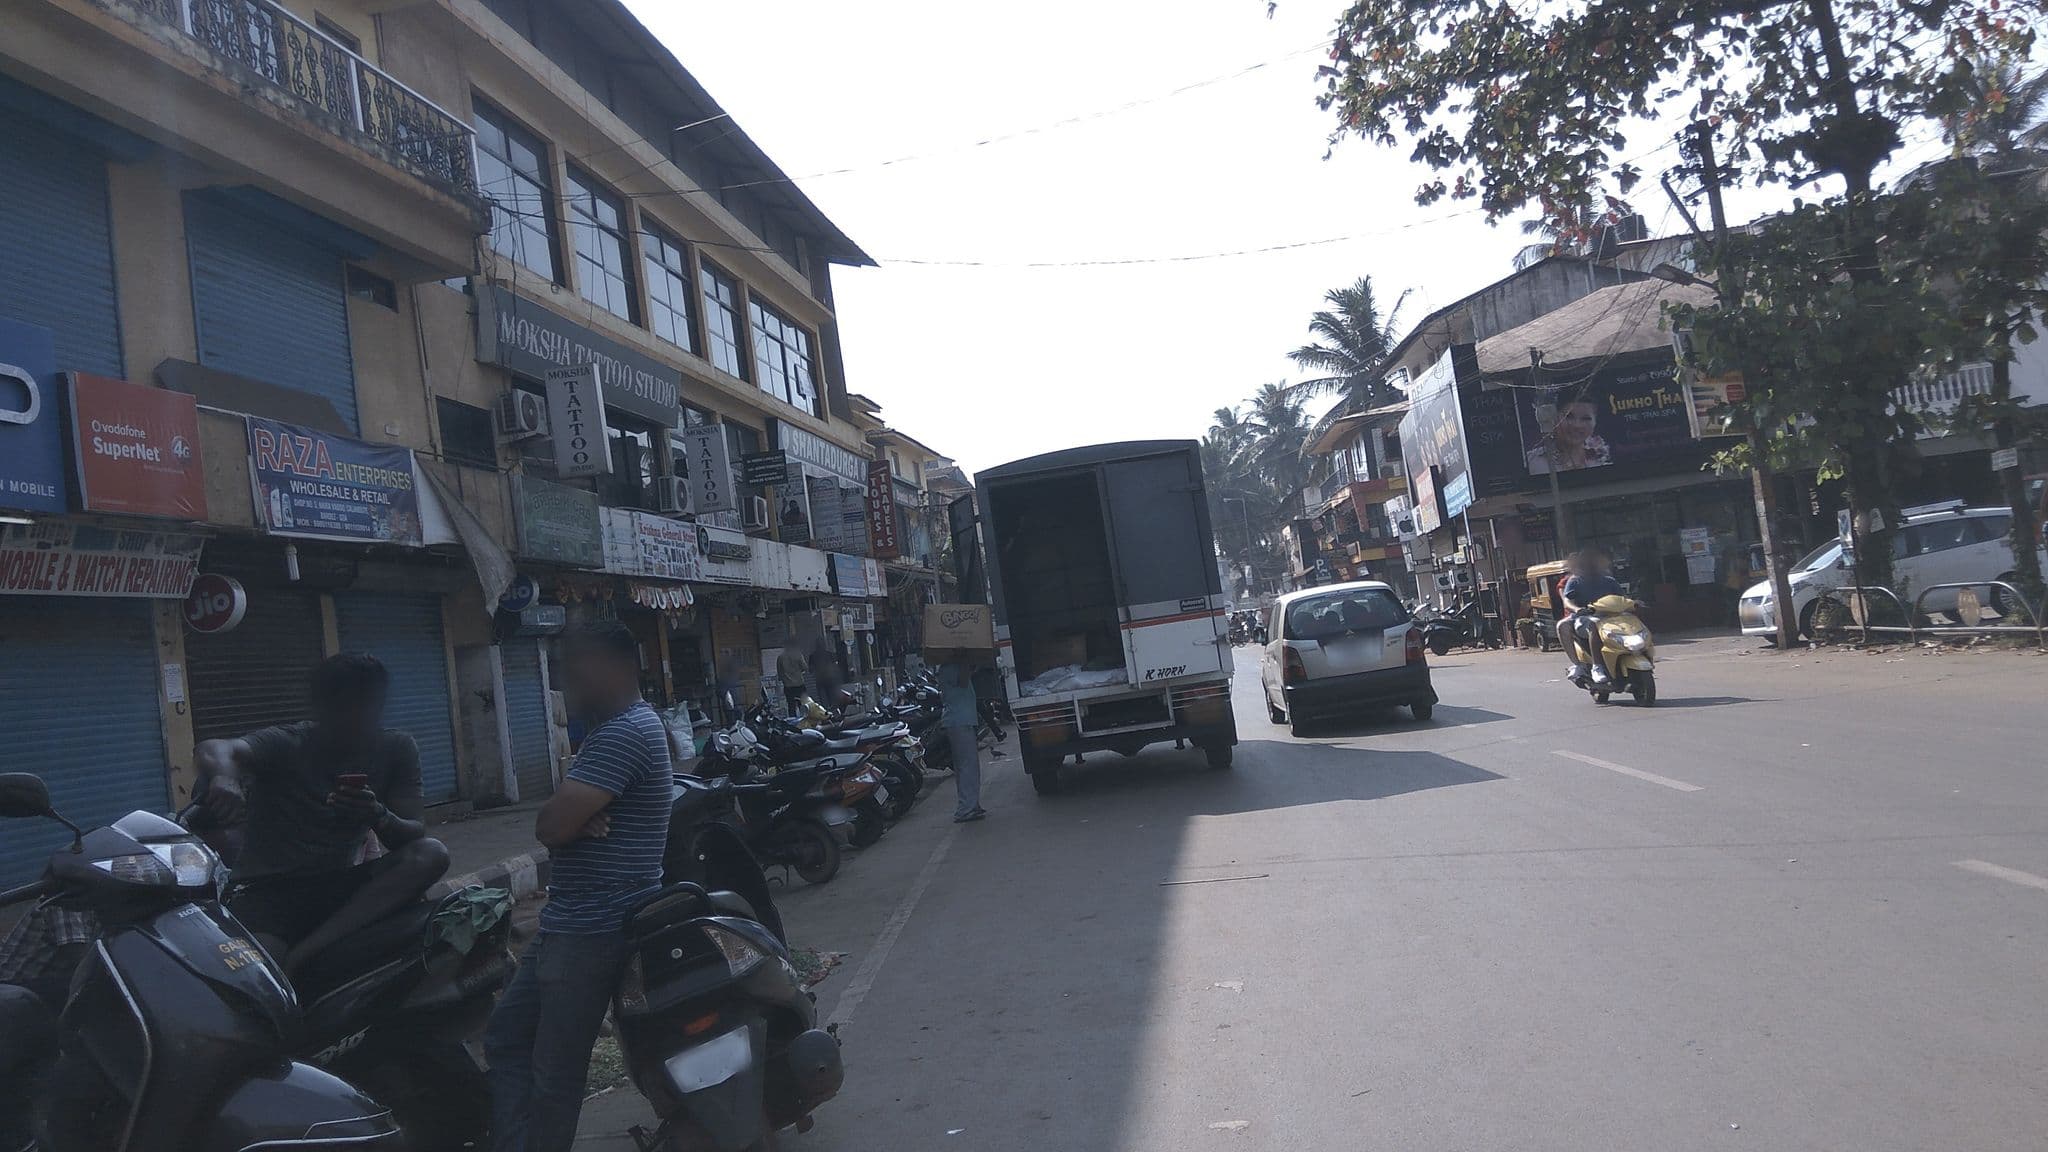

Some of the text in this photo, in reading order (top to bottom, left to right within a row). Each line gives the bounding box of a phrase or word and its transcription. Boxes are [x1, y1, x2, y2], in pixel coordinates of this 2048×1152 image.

[500, 312, 677, 409] MOKSHA TATTOO STUDIO
[548, 366, 591, 380] MOKSHA
[1608, 393, 1654, 416] SUKHO
[1652, 387, 1683, 409] THA
[102, 422, 146, 439] vodafone
[563, 381, 590, 465] TATTOO
[93, 436, 161, 462] SuperNet
[255, 428, 411, 490] RAZA ENTERPRISES
[792, 431, 859, 480] SHANTADURGA
[698, 437, 718, 502] TATTOO
[9, 480, 56, 497] MOBILE
[289, 480, 391, 505] WHOLESALE & RETAIL
[869, 472, 894, 548] TOURS & TRAVELS
[57, 553, 72, 591] &
[73, 553, 127, 592] WATCH
[125, 557, 197, 595] REPAIRING
[1157, 665, 1186, 679] HORN
